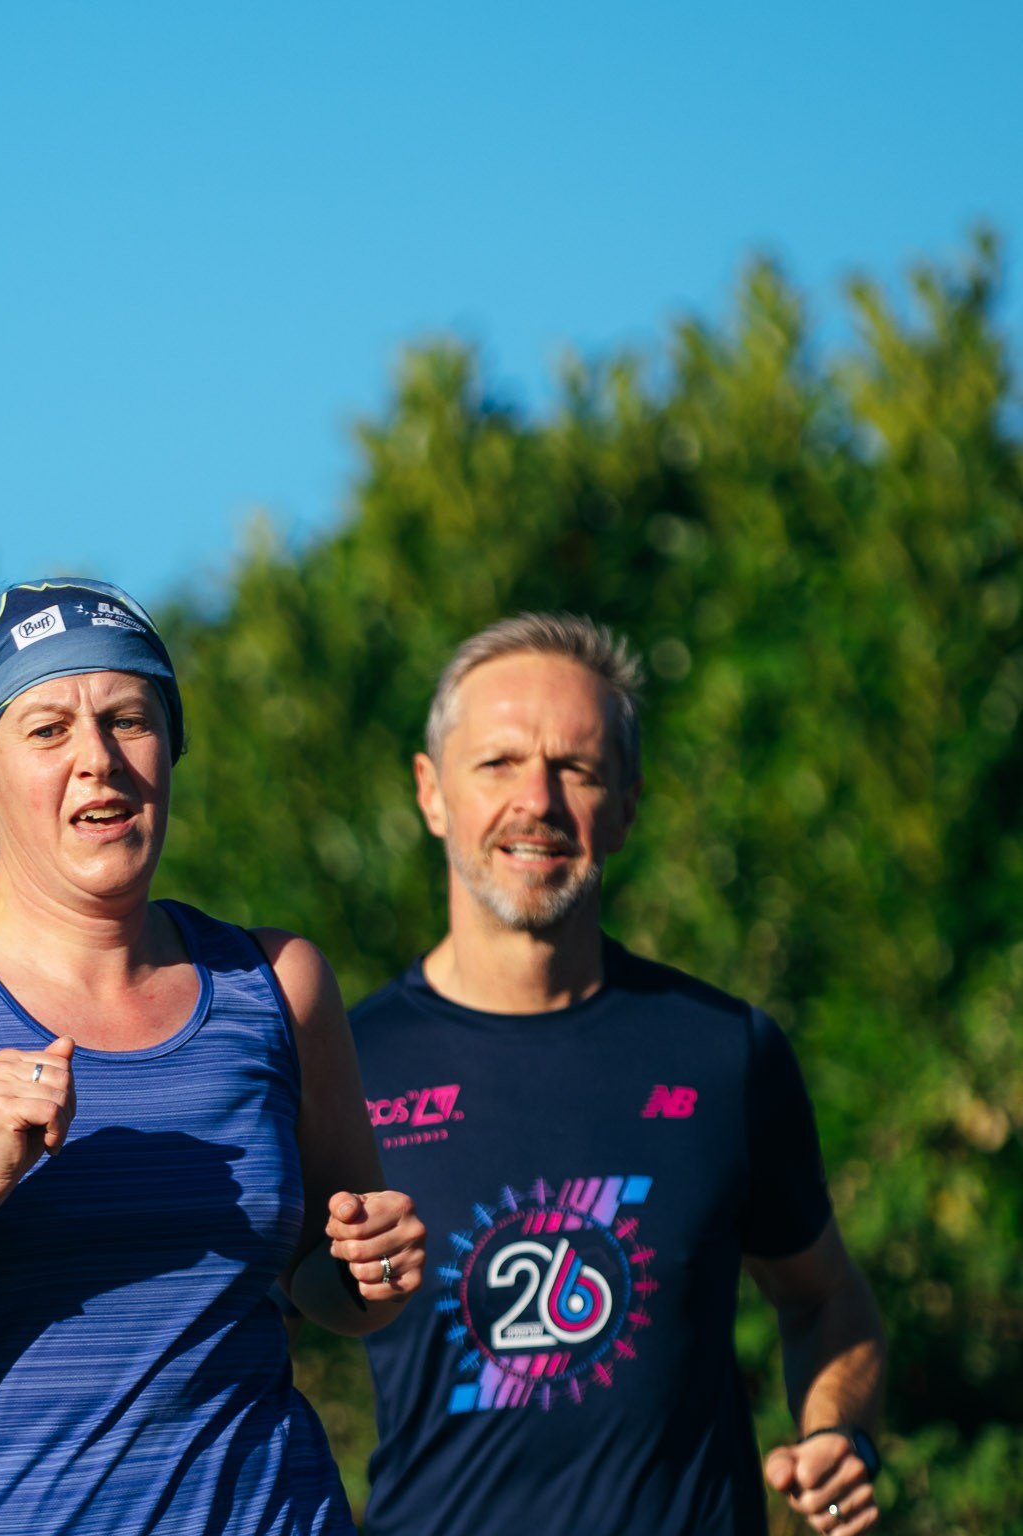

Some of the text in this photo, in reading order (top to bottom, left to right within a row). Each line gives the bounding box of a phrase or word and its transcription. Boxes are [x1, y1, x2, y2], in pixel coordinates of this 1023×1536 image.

[22, 615, 51, 636] Buff
[641, 1084, 698, 1119] NB
[486, 1238, 613, 1350] 26
